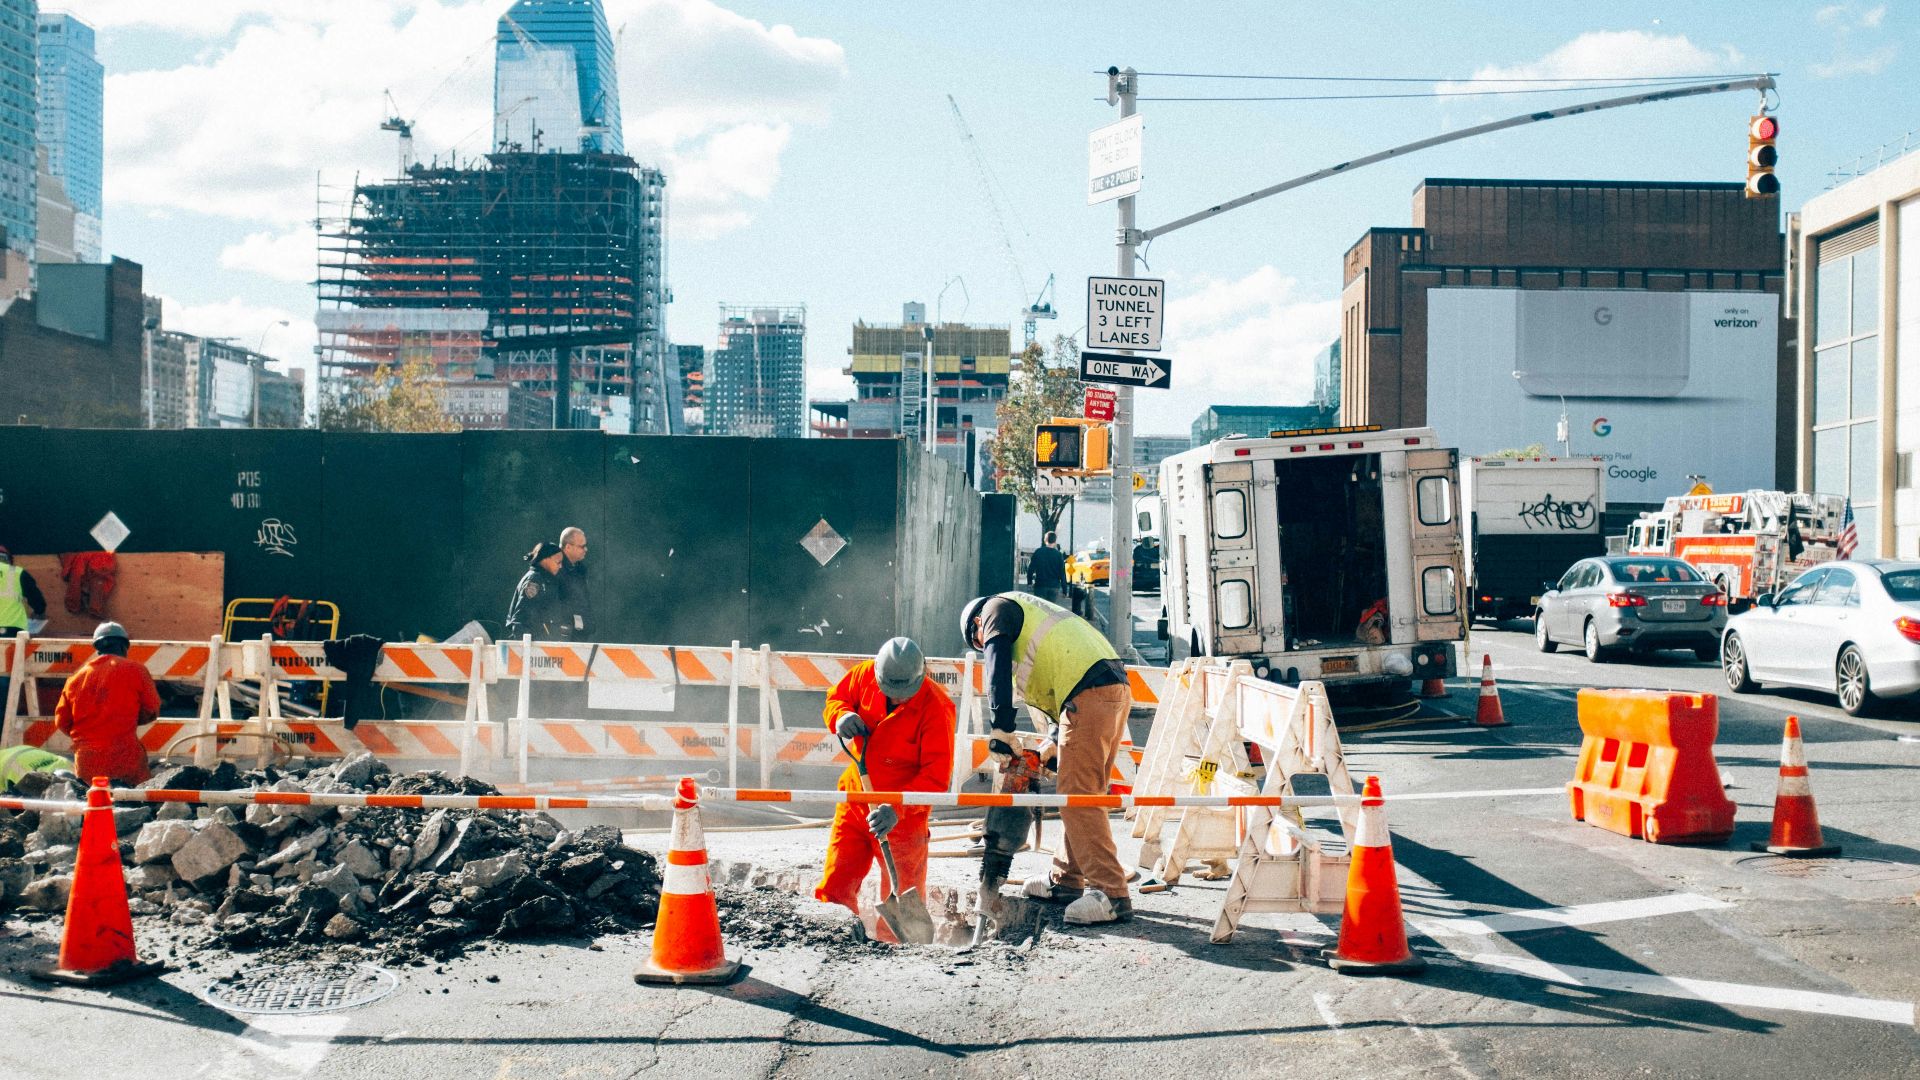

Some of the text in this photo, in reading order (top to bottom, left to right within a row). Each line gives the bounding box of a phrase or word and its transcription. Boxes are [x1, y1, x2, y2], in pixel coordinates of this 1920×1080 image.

[1115, 126, 1139, 146] BLOCK
[1100, 147, 1129, 164] THE BOX
[1116, 168, 1138, 186] POINTS
[1095, 283, 1158, 297] LINCOLN
[1097, 299, 1154, 313] TUNNEL
[1098, 315, 1151, 328] 3 LEFT
[1714, 317, 1758, 328] verizon
[1100, 332, 1149, 344] LANES
[1094, 362, 1158, 378] ONE WAY
[1087, 390, 1114, 400] NO STANDING
[1592, 417, 1612, 437] G
[1615, 452, 1632, 460] Pixel
[1608, 465, 1657, 482] Google
[1805, 550, 1833, 560] RUCK
[33, 651, 73, 664] TRIUMPH
[522, 655, 563, 669] RIUMPH
[276, 732, 315, 745] TRIUMPH
